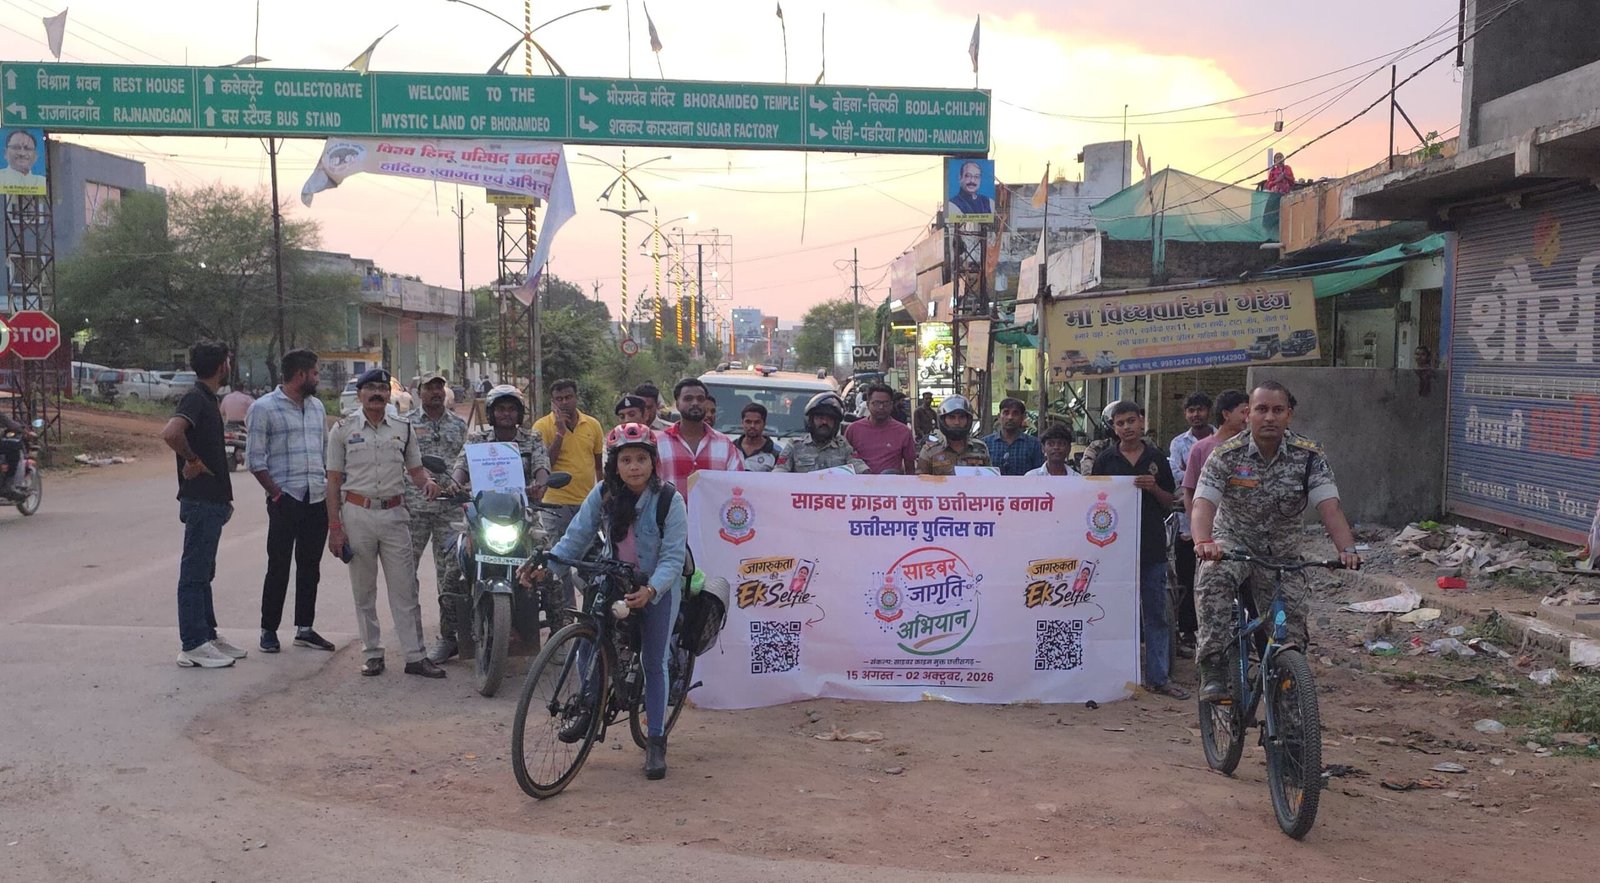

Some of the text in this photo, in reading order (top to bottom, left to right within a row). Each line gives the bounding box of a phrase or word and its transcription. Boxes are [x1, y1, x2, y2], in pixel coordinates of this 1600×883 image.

[37, 68, 101, 91] विश्राम भवन
[113, 77, 184, 94] REST HOUSE
[274, 81, 363, 98] COLLECTORATE
[408, 84, 535, 103] WELCOME TO THE
[607, 84, 676, 107] भोरमदेव मंदिर
[38, 97, 101, 122] राजनांदगाँव
[683, 93, 799, 111] BHORAMDEO TEMPLE
[905, 100, 986, 117] BODLA-CHILPHI
[113, 107, 192, 124] RAJNANDGAON
[221, 104, 272, 126] बस स्टैण्ड
[277, 111, 341, 128] BUS STAND
[381, 113, 550, 133] MYSTIC LAND OF BHORAMDEO
[609, 119, 694, 136] शक्कर कारखाना
[697, 122, 779, 139] SUGAR FACTORY
[898, 128, 985, 145] PONDI-PANDARIYA
[421, 144, 457, 164] हिन्दू
[461, 147, 510, 165] परिषद
[483, 173, 503, 185] एवं
[12, 327, 56, 343] STOP
[853, 346, 877, 357] OLA
[791, 492, 1055, 516] साइबर क्राइम मुक्त छत्तीसगढ़ बनाने
[1461, 472, 1588, 518] Forever With You
[849, 515, 995, 542] छत्तीसगढ़ पुलिस का
[902, 558, 958, 580] साइबर
[735, 579, 769, 609] Ek
[908, 575, 966, 605] जागृति
[1024, 580, 1055, 609] Ek
[897, 609, 970, 640] अभियान
[846, 670, 858, 682] 15
[861, 670, 893, 682] अगस्त
[906, 671, 920, 681] 02
[967, 672, 994, 683] 2026
